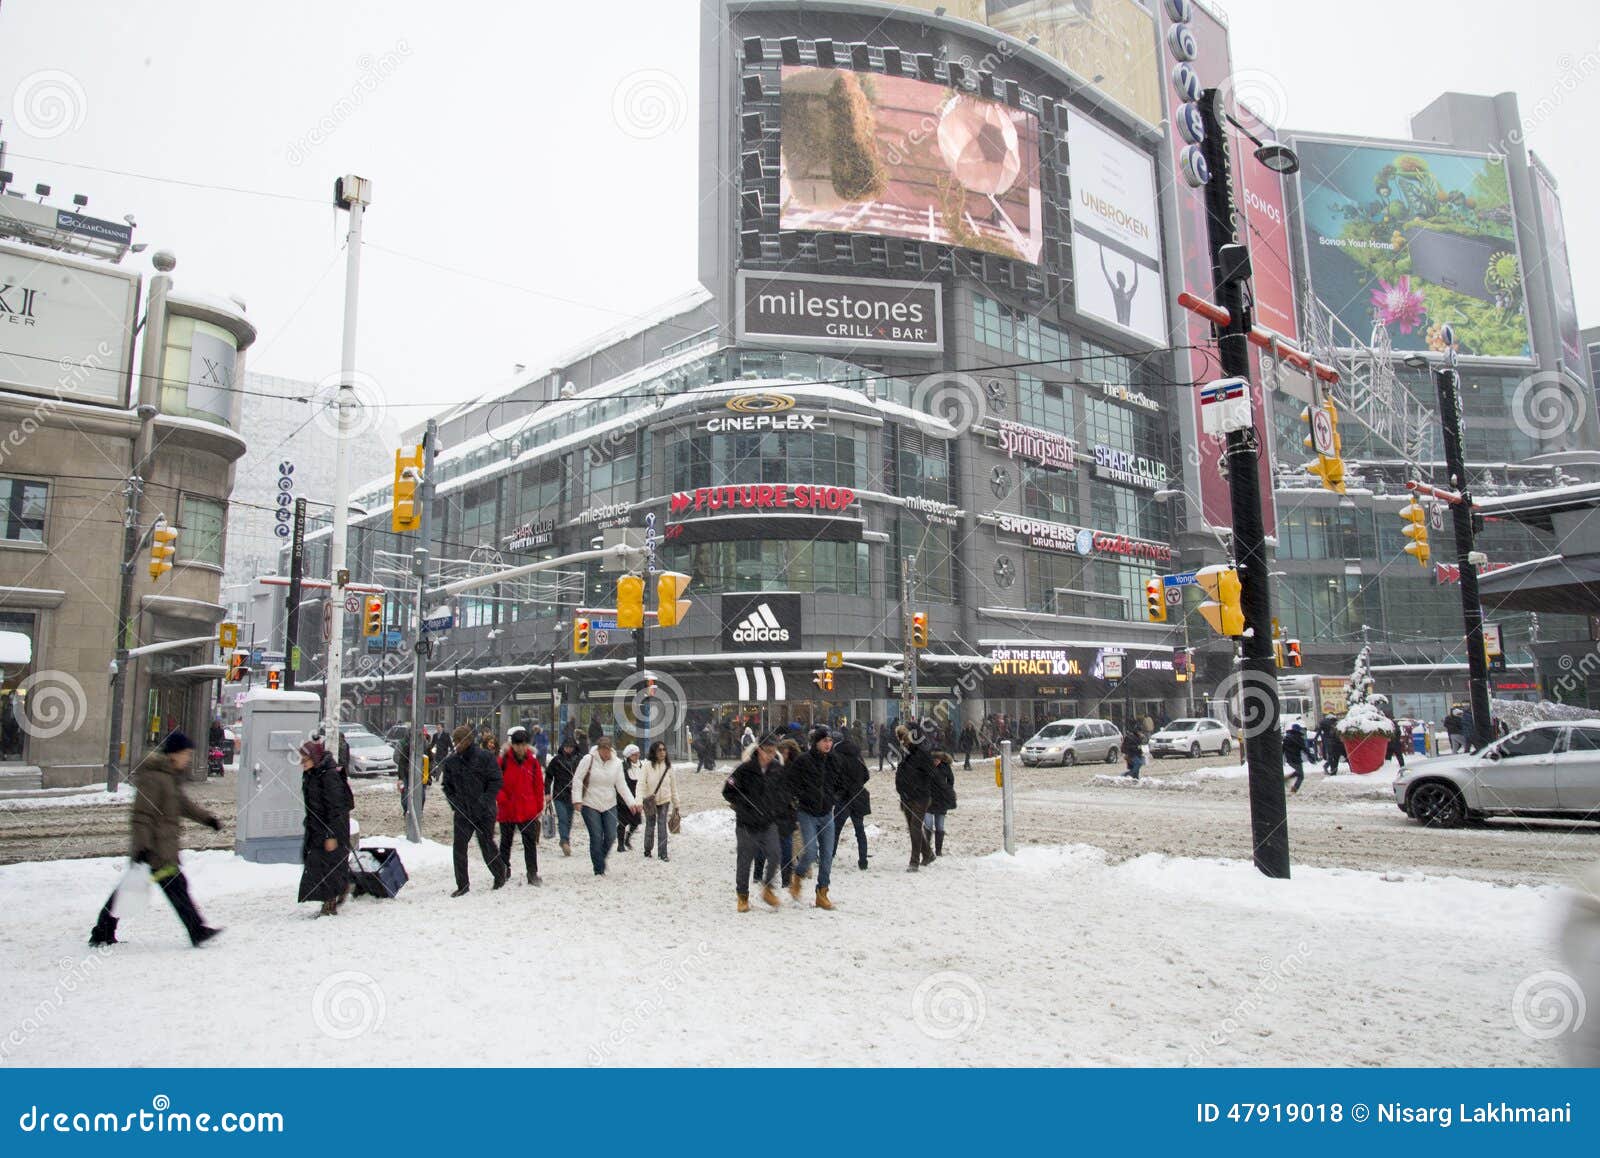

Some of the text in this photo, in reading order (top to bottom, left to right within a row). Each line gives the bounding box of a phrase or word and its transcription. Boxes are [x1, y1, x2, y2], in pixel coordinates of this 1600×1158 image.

[1080, 189, 1149, 239] UNBROKEN
[1244, 189, 1281, 225] SONOS
[1319, 236, 1394, 250] Sonos Your Home
[759, 289, 923, 322] milestones
[826, 323, 924, 340] GRILL BAR
[706, 415, 816, 432] CINEPLEX
[1095, 445, 1137, 472] SHARK
[1137, 457, 1167, 481] CLUB
[695, 486, 855, 511] FUTURE SHOP
[579, 502, 630, 525] milestones
[1000, 516, 1077, 542] SHOPPERS
[1033, 537, 1076, 551] DRUG MART
[1134, 541, 1171, 561] FITNESS
[733, 627, 790, 642] adidas
[992, 650, 1066, 661] FOR THE FEATURE
